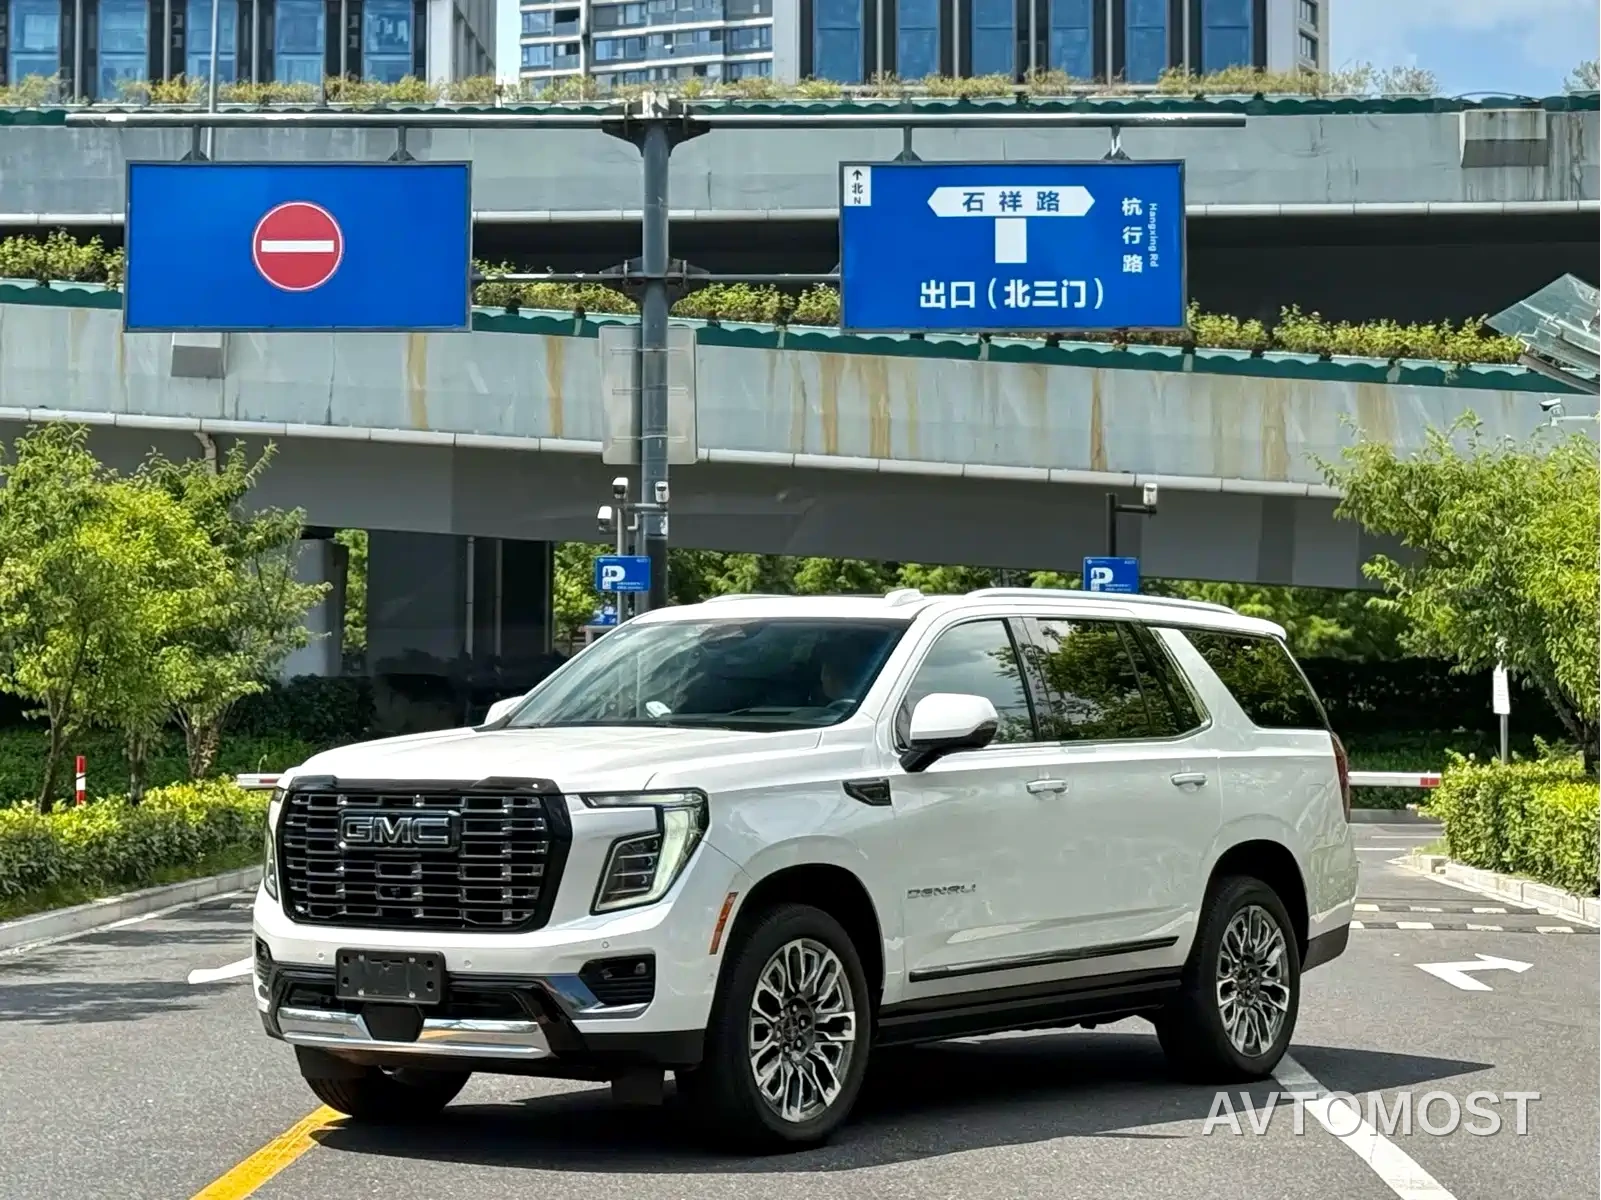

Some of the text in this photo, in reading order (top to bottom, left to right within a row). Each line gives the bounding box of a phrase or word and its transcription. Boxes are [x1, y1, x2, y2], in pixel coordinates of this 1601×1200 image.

[851, 182, 864, 195] 北
[853, 196, 862, 205] N
[962, 190, 1061, 213] 石祥路
[1121, 197, 1143, 274] 杭行路
[1147, 202, 1160, 268] Hangxing Rd
[919, 277, 1104, 310] 出口（北三门）
[341, 815, 450, 845] GMC
[907, 883, 976, 899] DENALI
